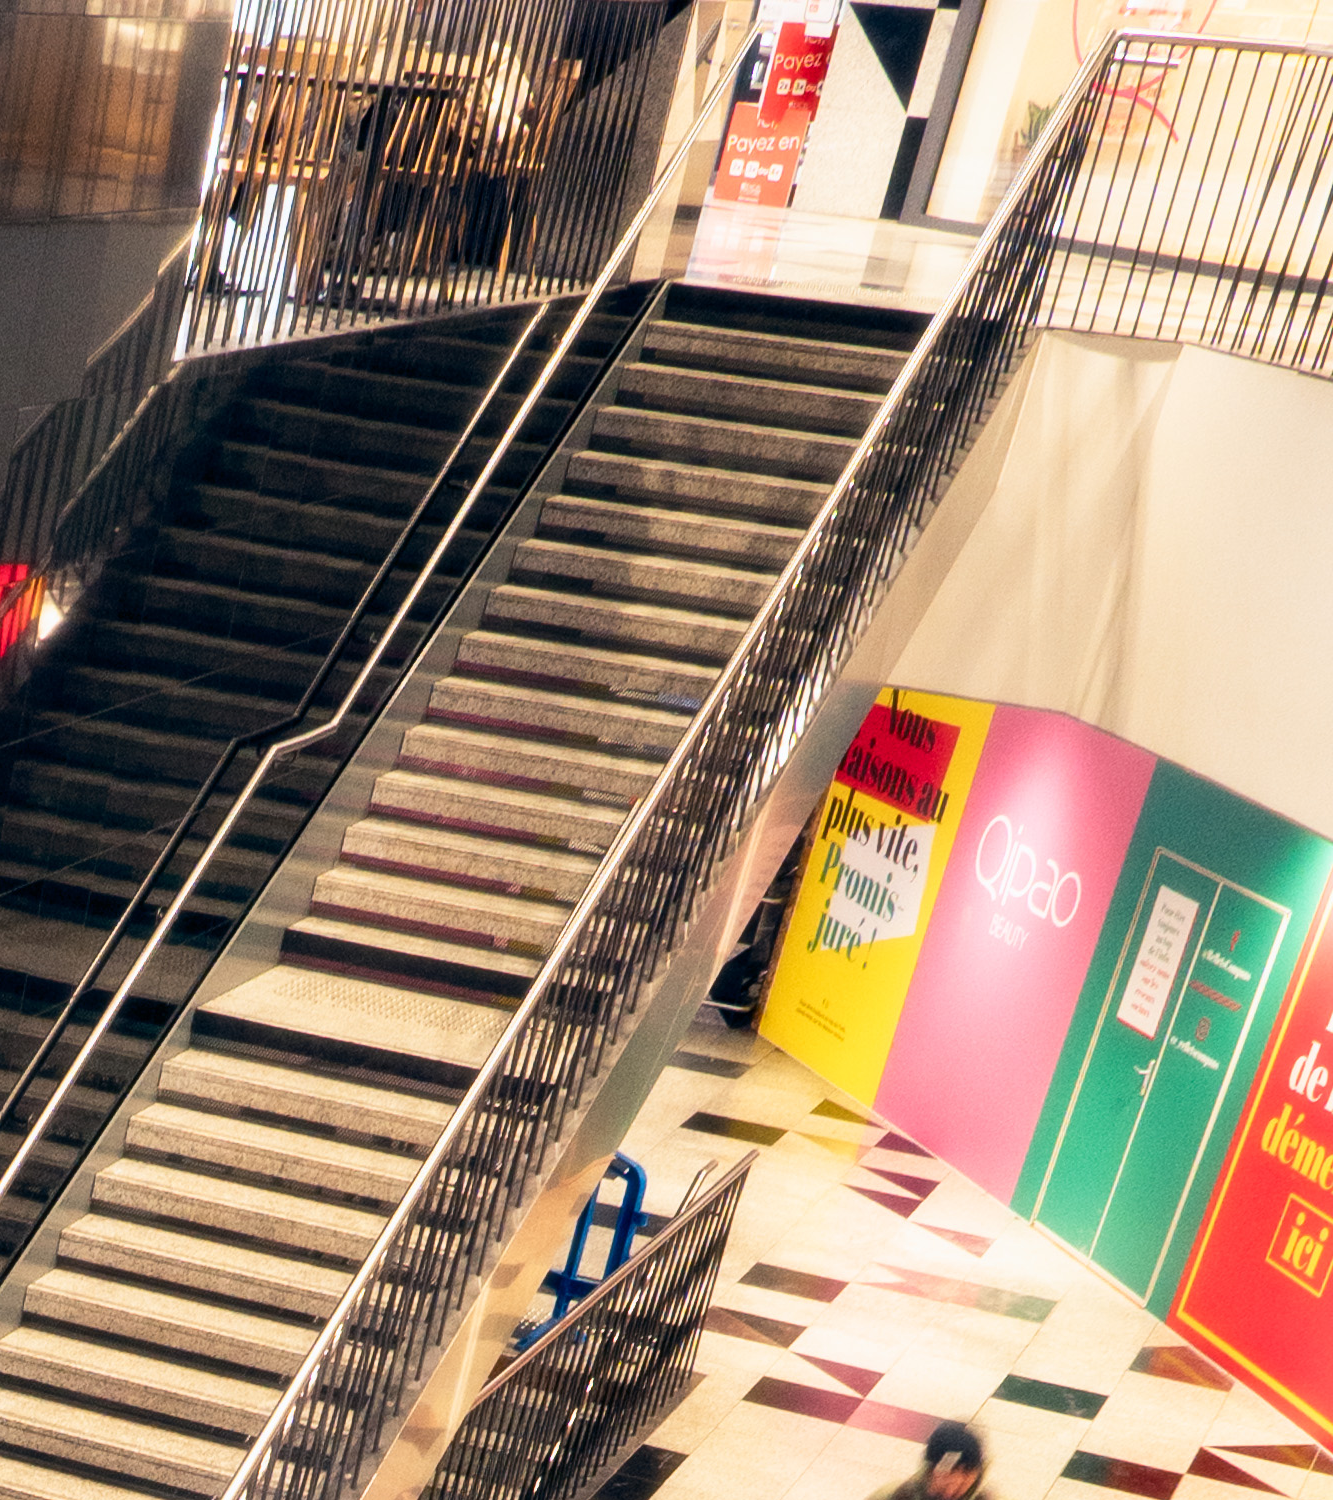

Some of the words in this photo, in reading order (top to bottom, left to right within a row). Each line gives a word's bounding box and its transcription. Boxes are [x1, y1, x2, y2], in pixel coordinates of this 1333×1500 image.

[772, 53, 822, 73] Payez
[726, 133, 775, 155] Payez
[778, 136, 800, 152] en
[884, 687, 937, 753] Nous
[918, 780, 950, 826] au
[821, 789, 875, 848] plus
[876, 812, 920, 884] vite,
[819, 841, 906, 924] Promis-
[974, 812, 1084, 931] Qipao
[807, 898, 862, 964] juré
[987, 910, 1031, 952] BEAUTY
[1288, 1040, 1329, 1103] de
[1280, 1210, 1330, 1280] ici
